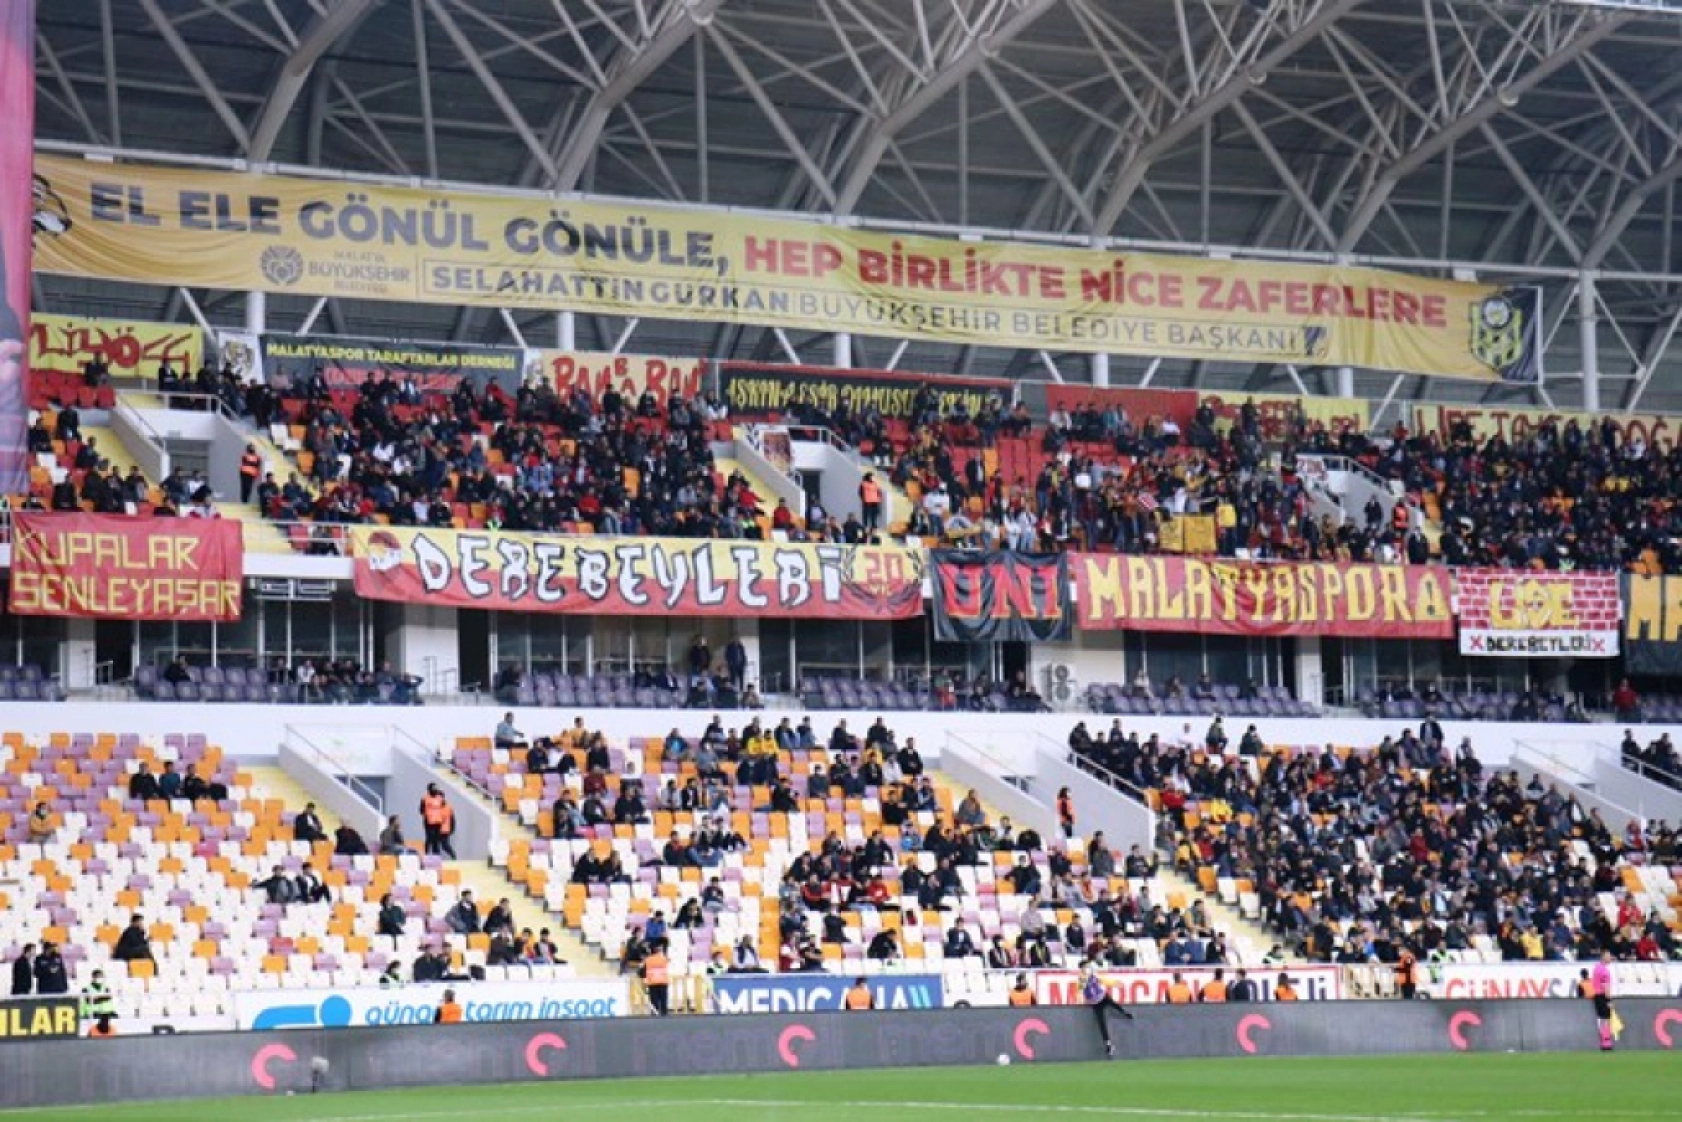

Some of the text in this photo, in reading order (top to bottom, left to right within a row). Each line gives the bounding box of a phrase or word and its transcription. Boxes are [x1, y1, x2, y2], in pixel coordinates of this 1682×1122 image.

[90, 183, 1448, 329] EL ELE GÖNÜL GÖNÜLE, HEP BİRLİKTE NİCE ZAFERLERE
[14, 528, 200, 571] KUPALAR
[1084, 557, 1452, 623] MALATYASPORA
